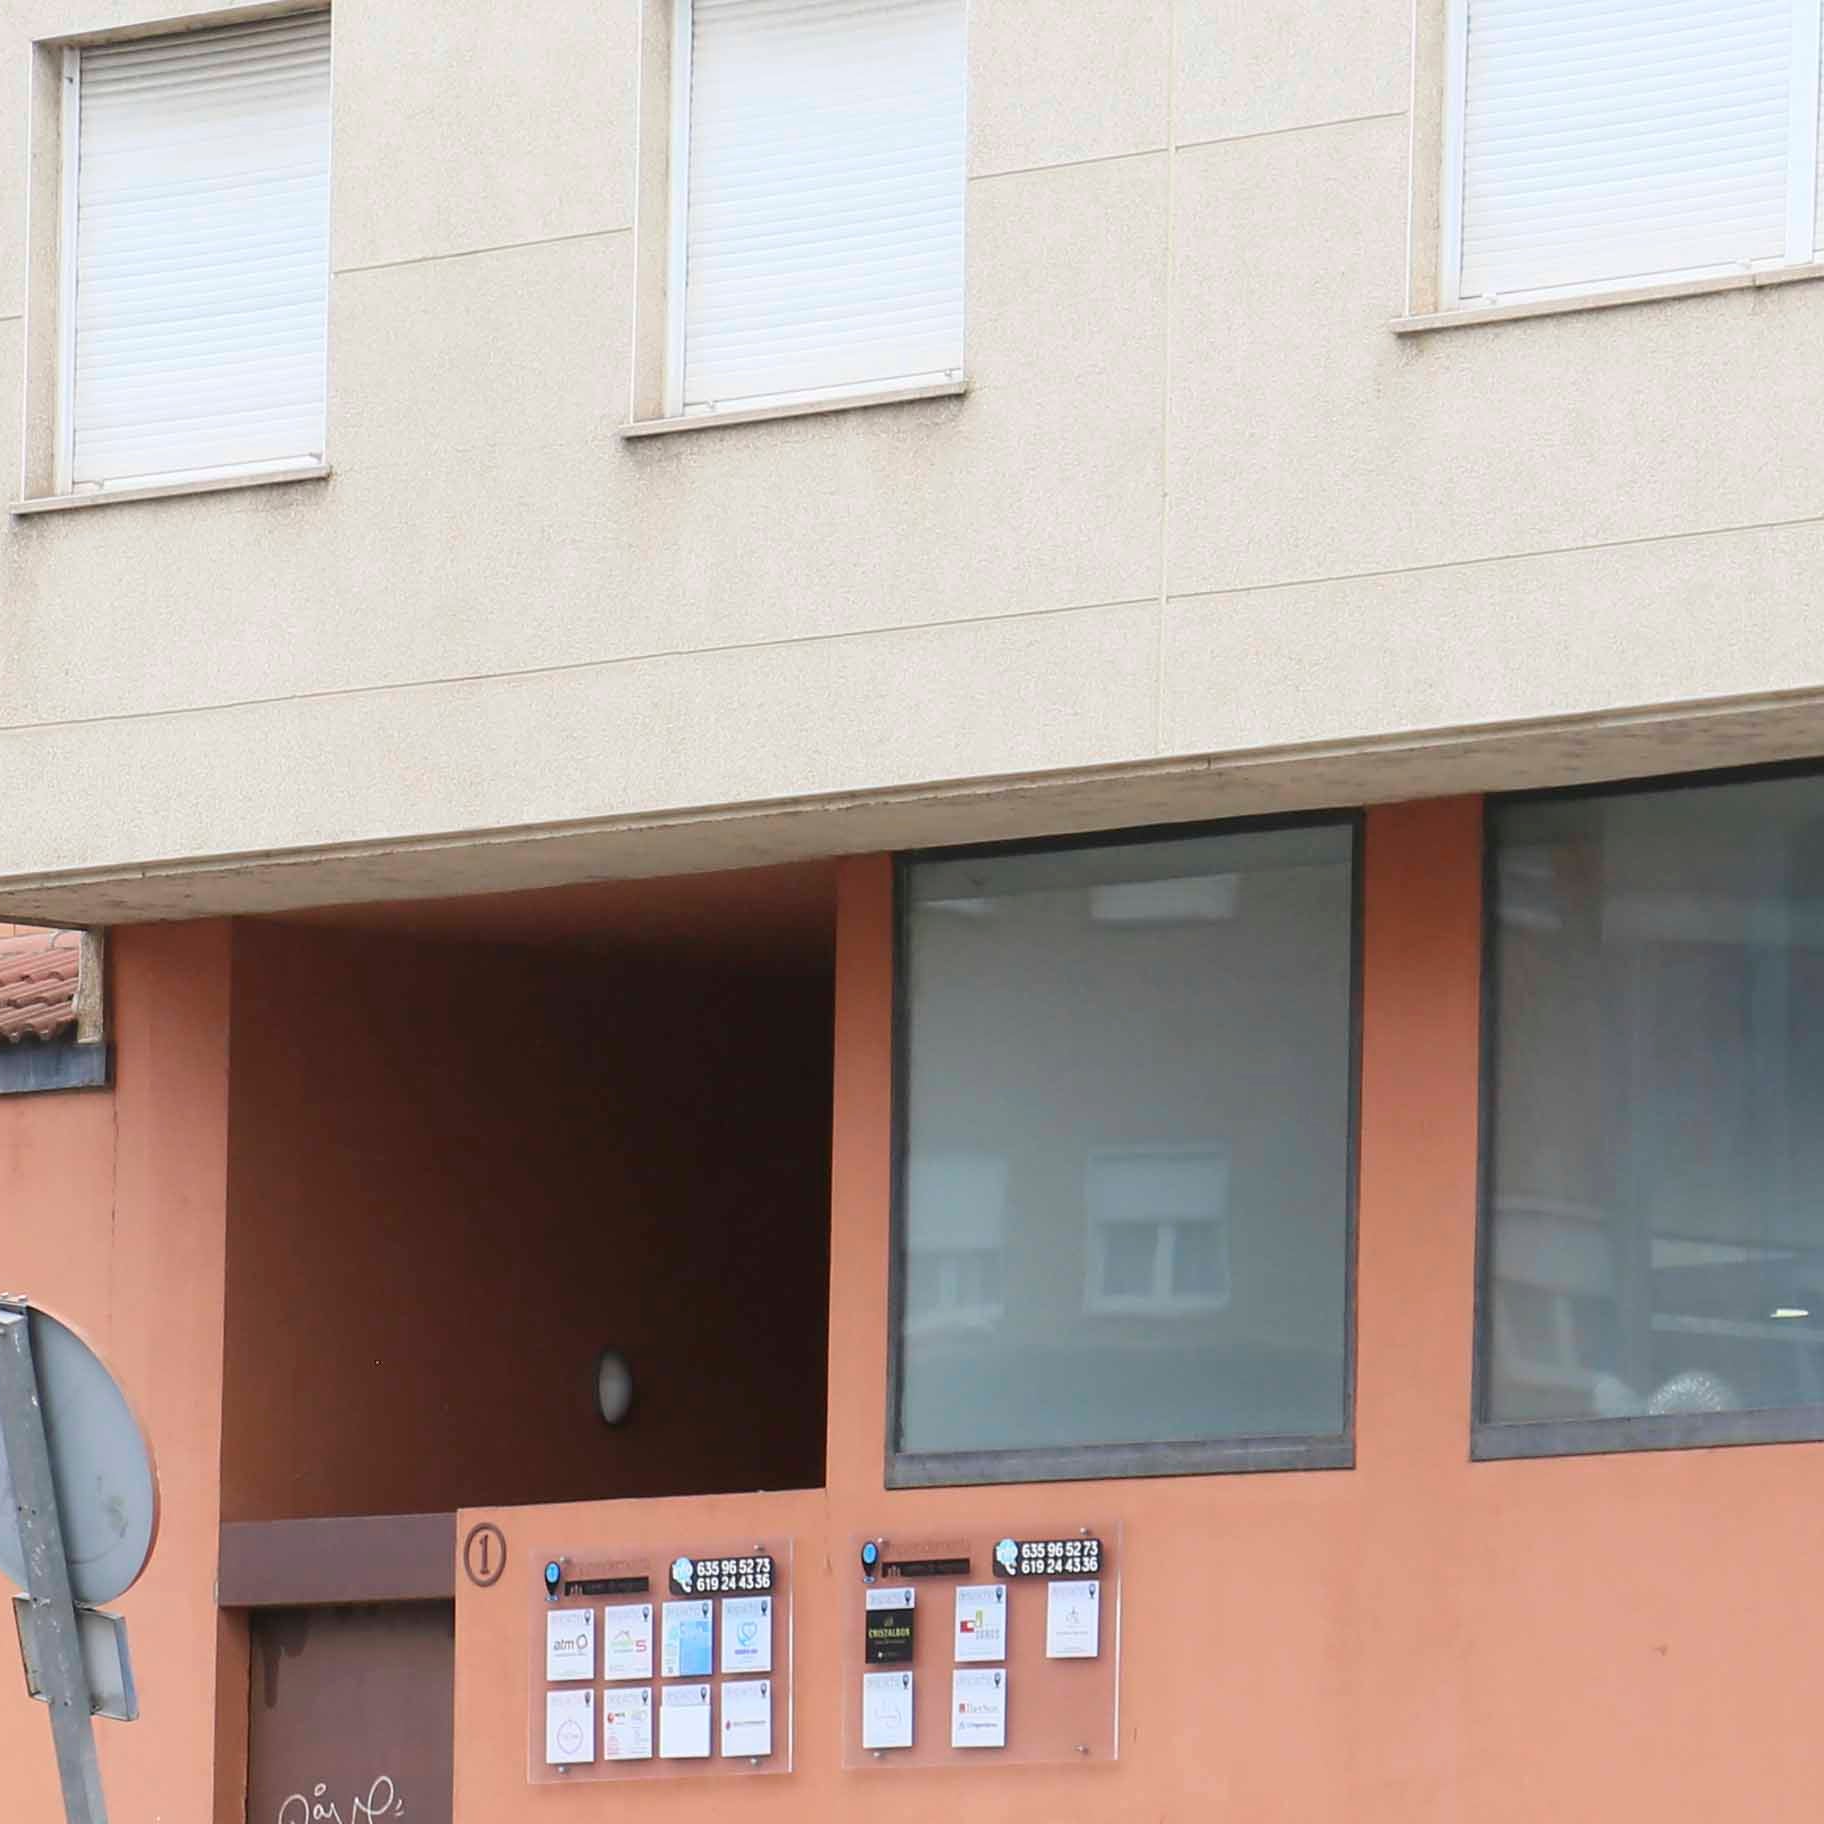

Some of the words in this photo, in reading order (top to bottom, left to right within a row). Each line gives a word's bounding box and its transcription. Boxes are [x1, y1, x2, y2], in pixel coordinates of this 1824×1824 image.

[1022, 1543, 1045, 1558] 635
[1047, 1542, 1064, 1557] 96
[1065, 1541, 1082, 1557] 52
[1083, 1540, 1098, 1556] 73
[696, 1561, 719, 1576] 635
[721, 1560, 737, 1575] 96
[738, 1559, 754, 1574] 52
[755, 1558, 771, 1573] 73
[1021, 1560, 1045, 1574] 619
[1046, 1559, 1063, 1573] 24
[1064, 1557, 1081, 1572] 43
[1082, 1557, 1098, 1572] 36
[696, 1577, 719, 1592] 619
[721, 1576, 736, 1591] 24
[738, 1574, 754, 1590] 43
[755, 1573, 771, 1589] 36
